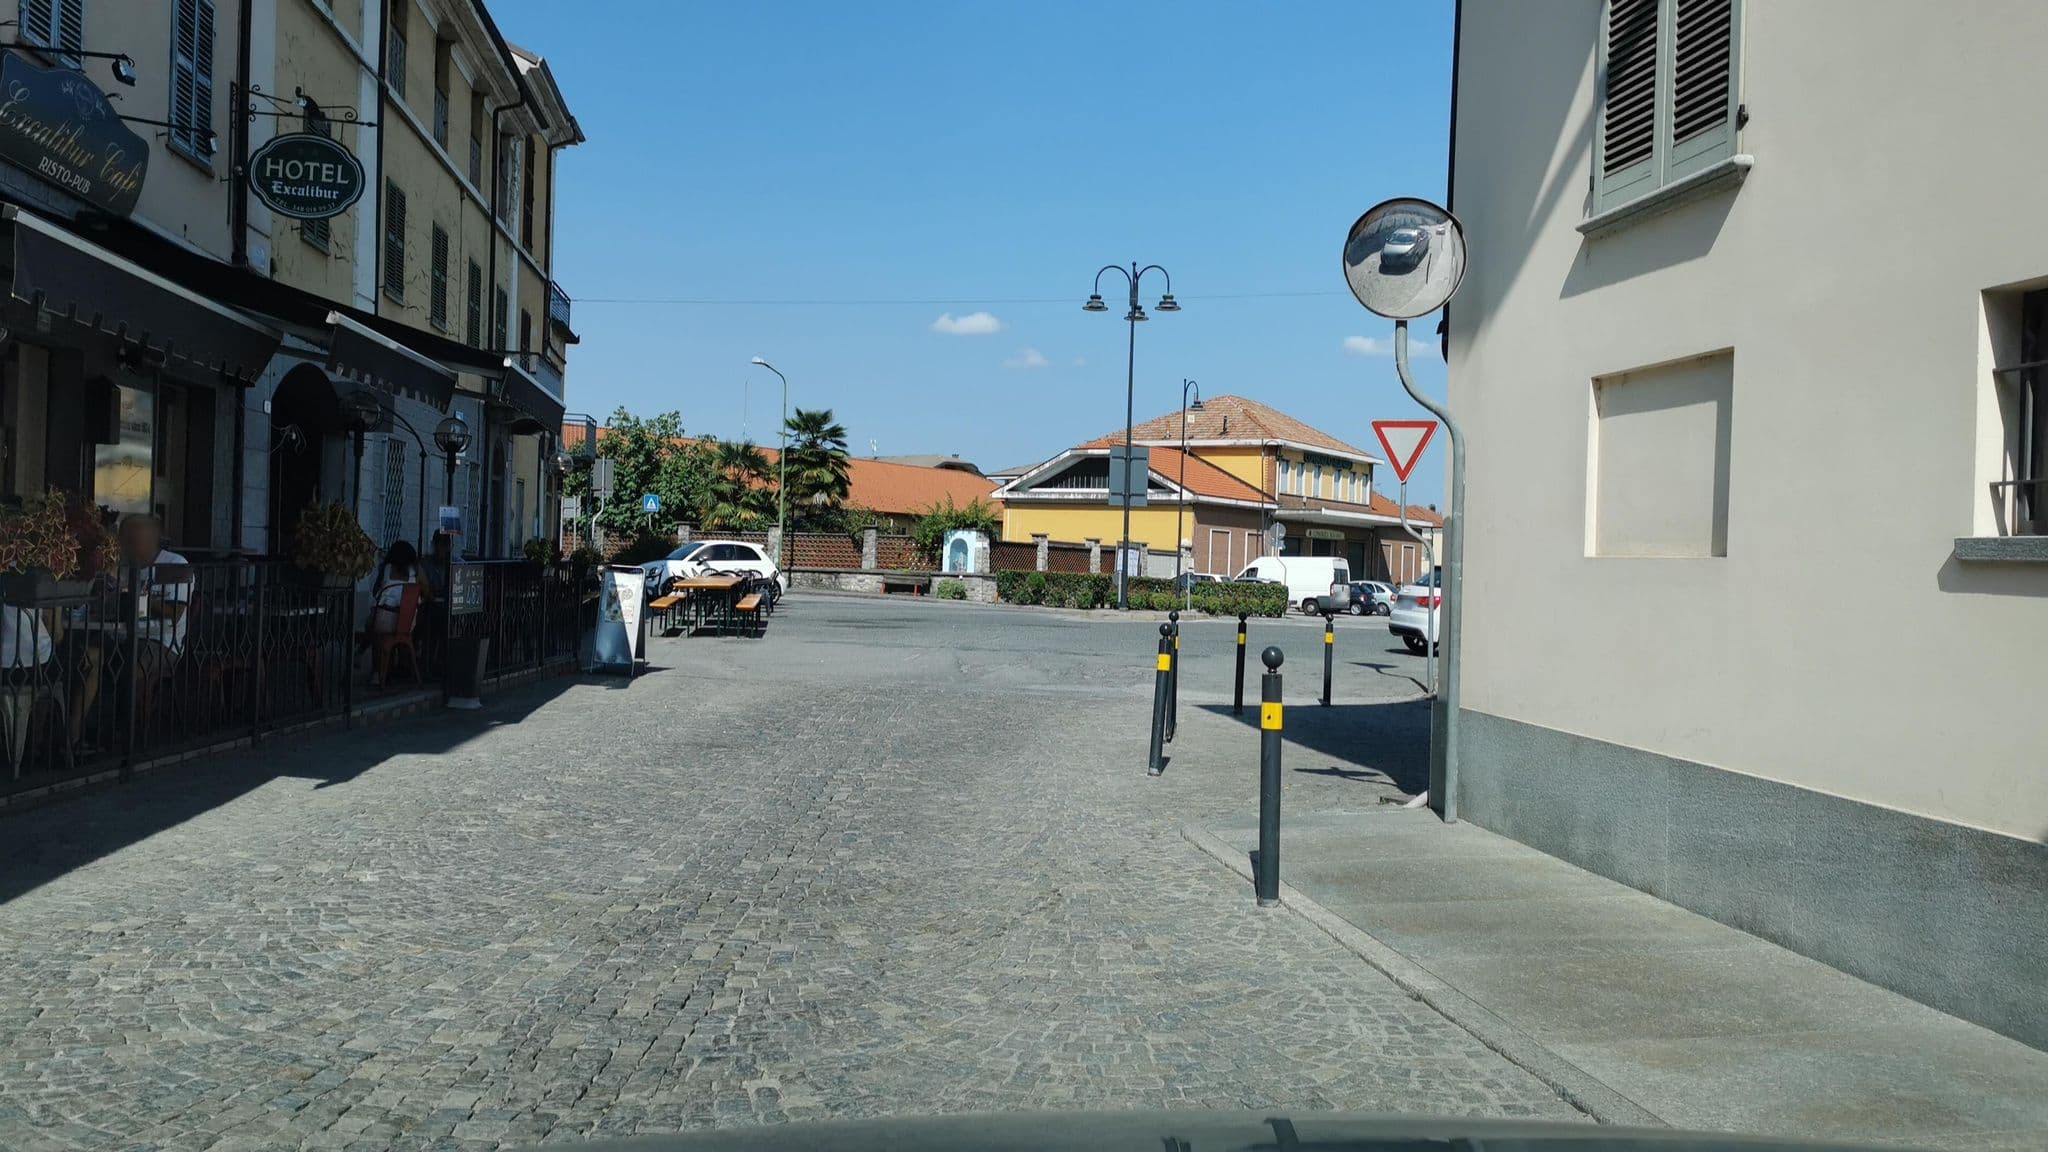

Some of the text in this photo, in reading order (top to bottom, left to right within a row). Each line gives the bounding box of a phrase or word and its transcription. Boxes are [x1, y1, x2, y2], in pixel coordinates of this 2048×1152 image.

[0, 79, 95, 168] Excalibur
[38, 156, 91, 194] RISTO-PUB
[266, 157, 350, 184] HOTEL
[271, 180, 339, 199] Excalibur
